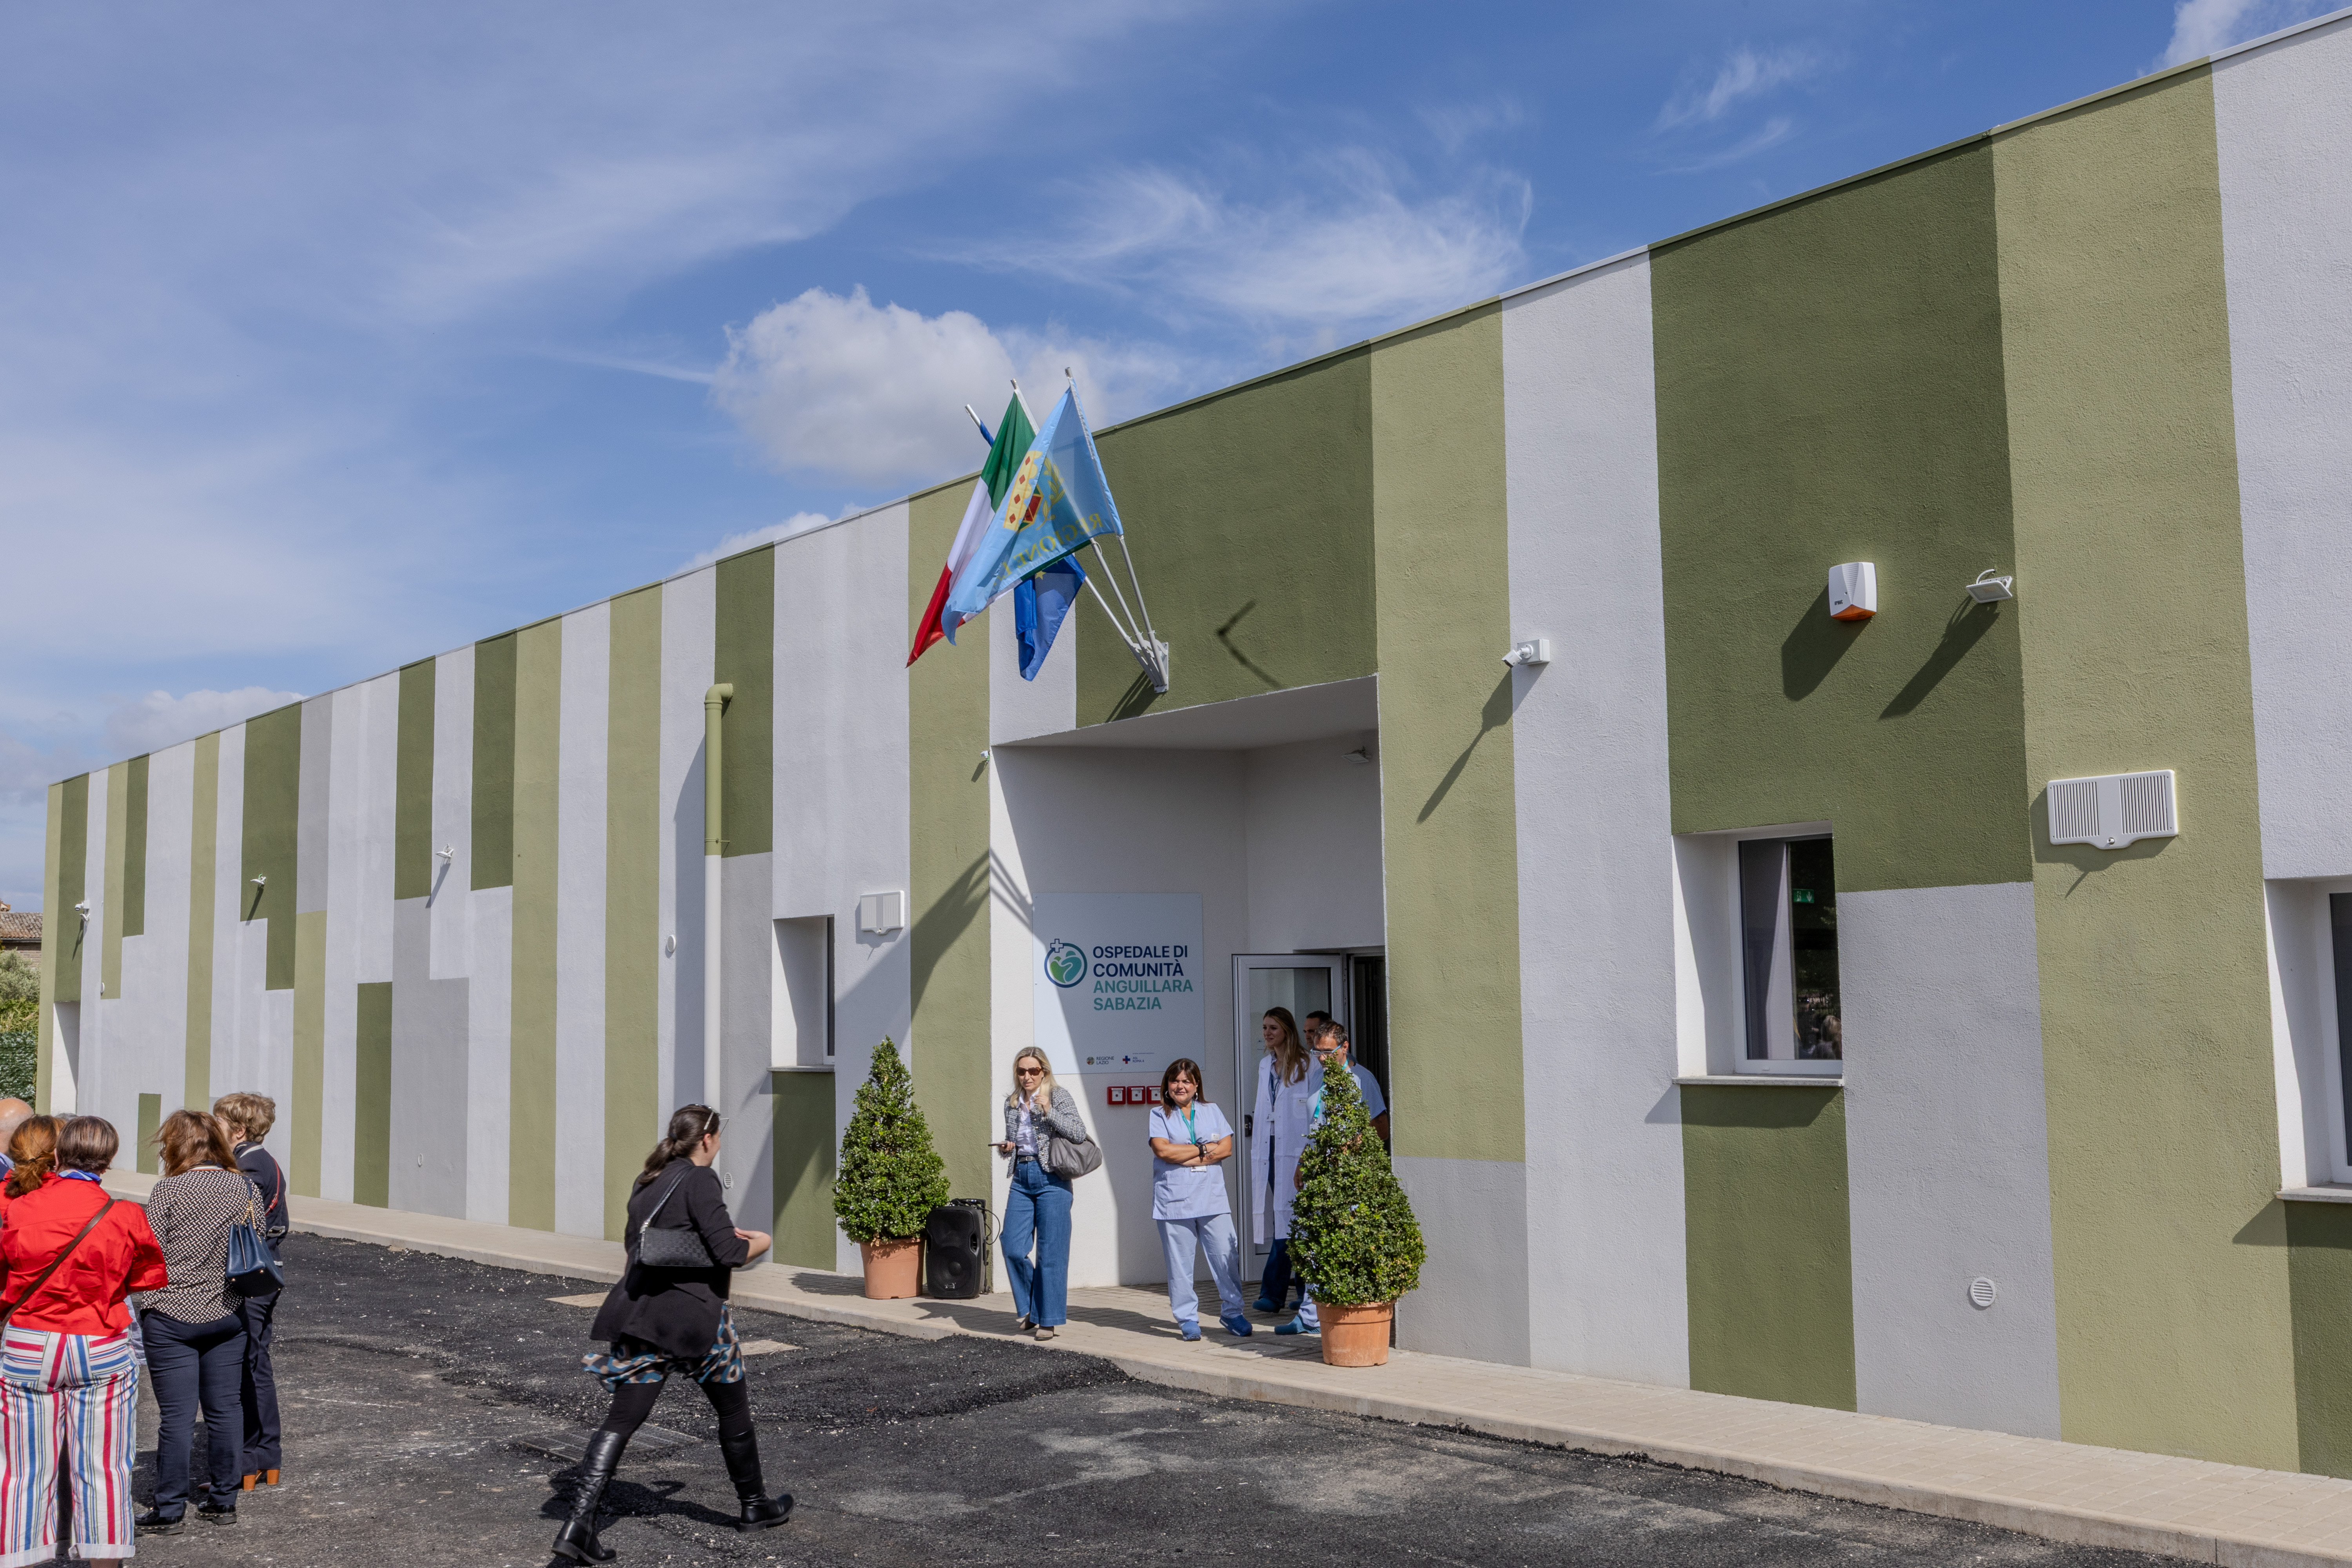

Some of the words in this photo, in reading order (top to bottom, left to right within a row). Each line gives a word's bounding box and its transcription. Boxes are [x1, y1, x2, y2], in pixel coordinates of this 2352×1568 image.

[1093, 946, 1170, 958] OSPEDALE
[1173, 945, 1188, 958] DI
[1093, 959, 1184, 977] COMUNITÀ
[1093, 979, 1193, 993] ANGUILLARA
[1094, 997, 1162, 1011] SABAZIA
